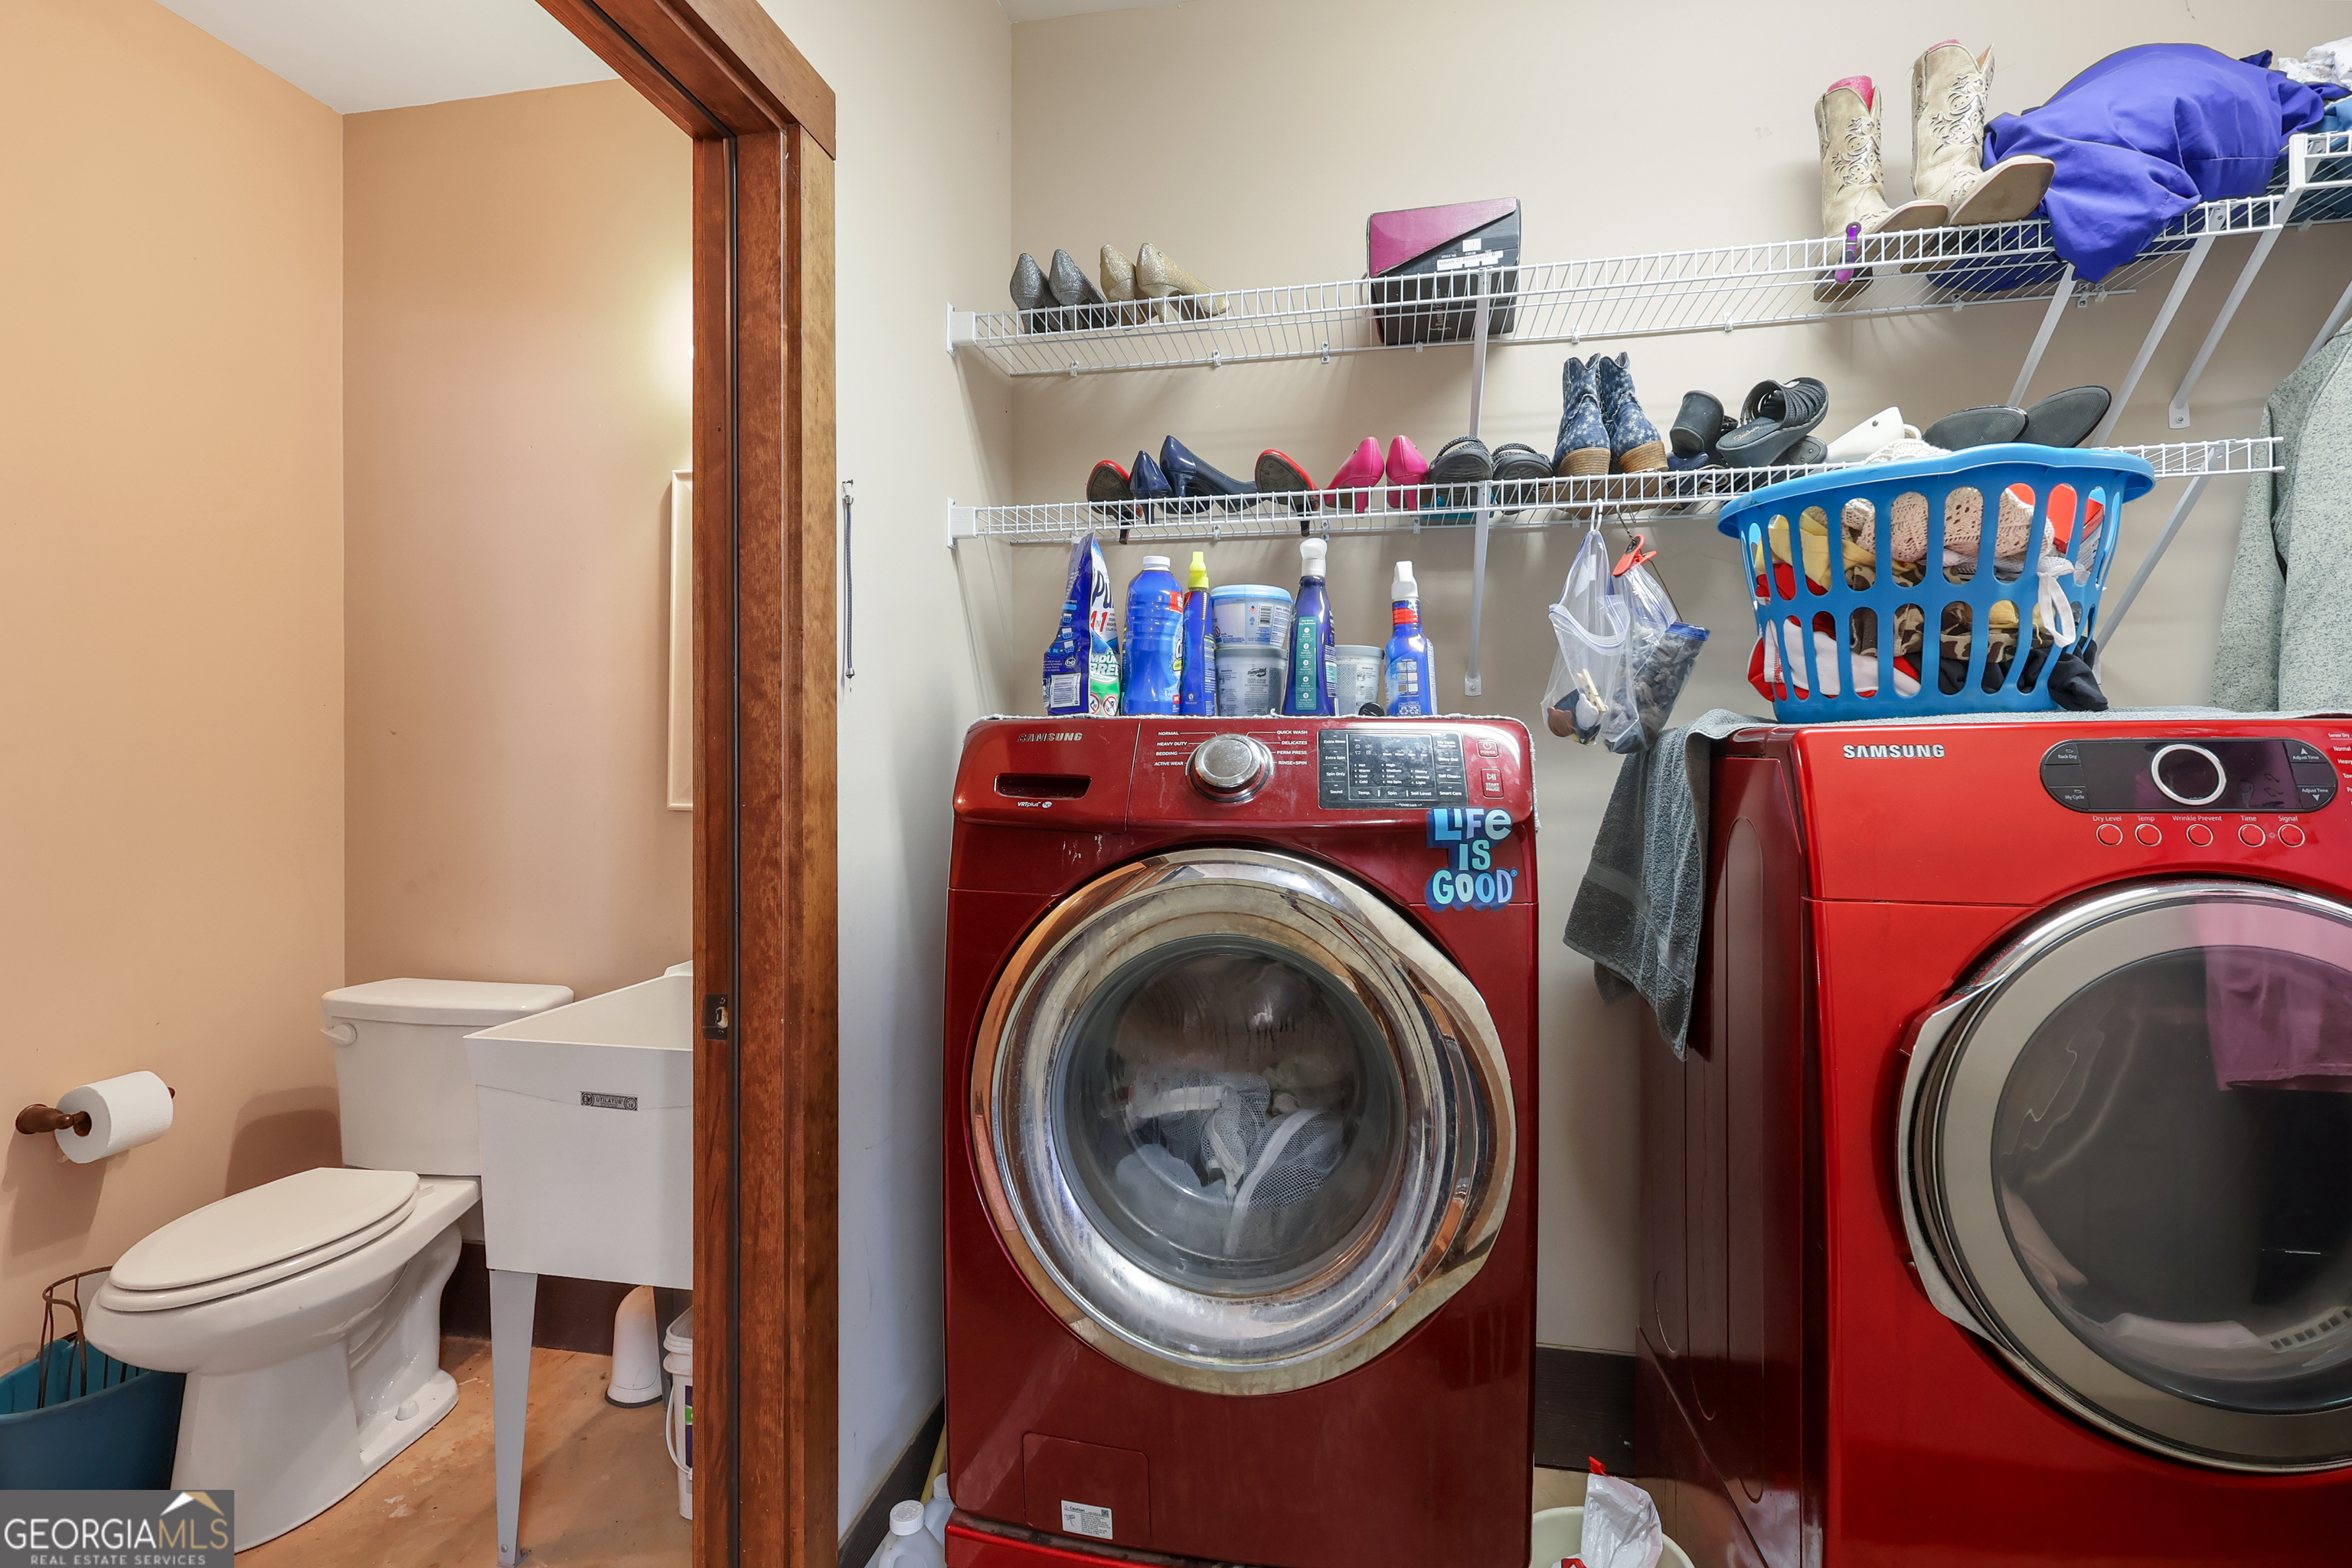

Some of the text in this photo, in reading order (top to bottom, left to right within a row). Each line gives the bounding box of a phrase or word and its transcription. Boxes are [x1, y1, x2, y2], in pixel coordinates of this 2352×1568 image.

[1018, 733, 1083, 742] SAMSUNG
[1843, 744, 1945, 759] SAMSUNG
[1459, 839, 1491, 871] IS
